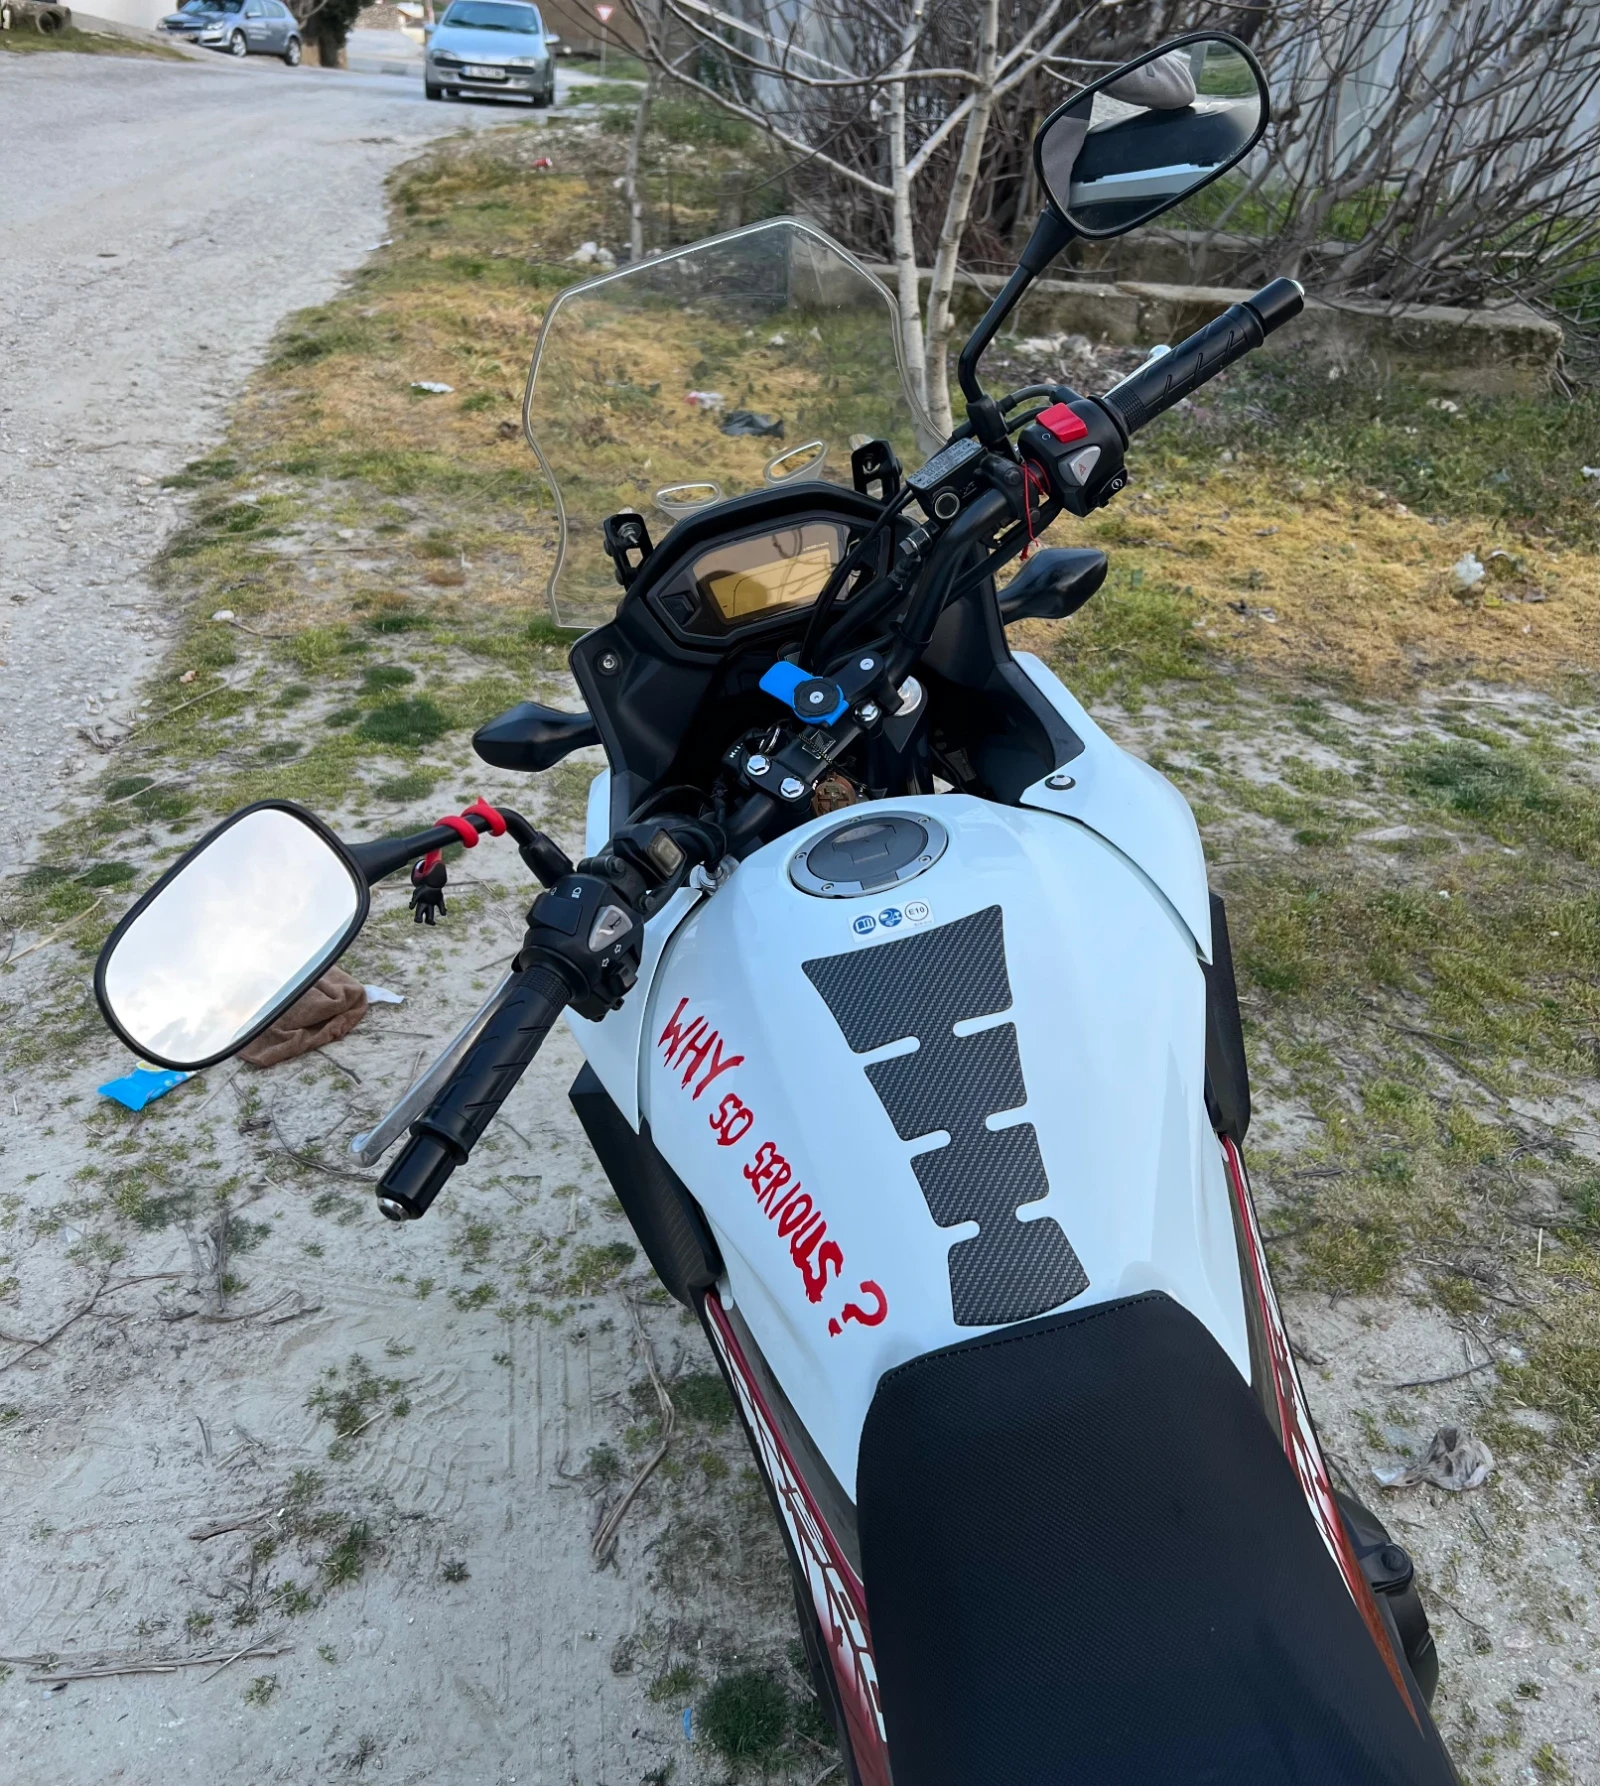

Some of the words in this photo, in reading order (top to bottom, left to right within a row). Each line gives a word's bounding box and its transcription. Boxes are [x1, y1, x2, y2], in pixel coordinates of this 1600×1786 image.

[908, 906, 925, 916] E10
[658, 997, 744, 1100] WHY
[709, 1092, 754, 1146] SO
[743, 1141, 844, 1304] SERIOUS
